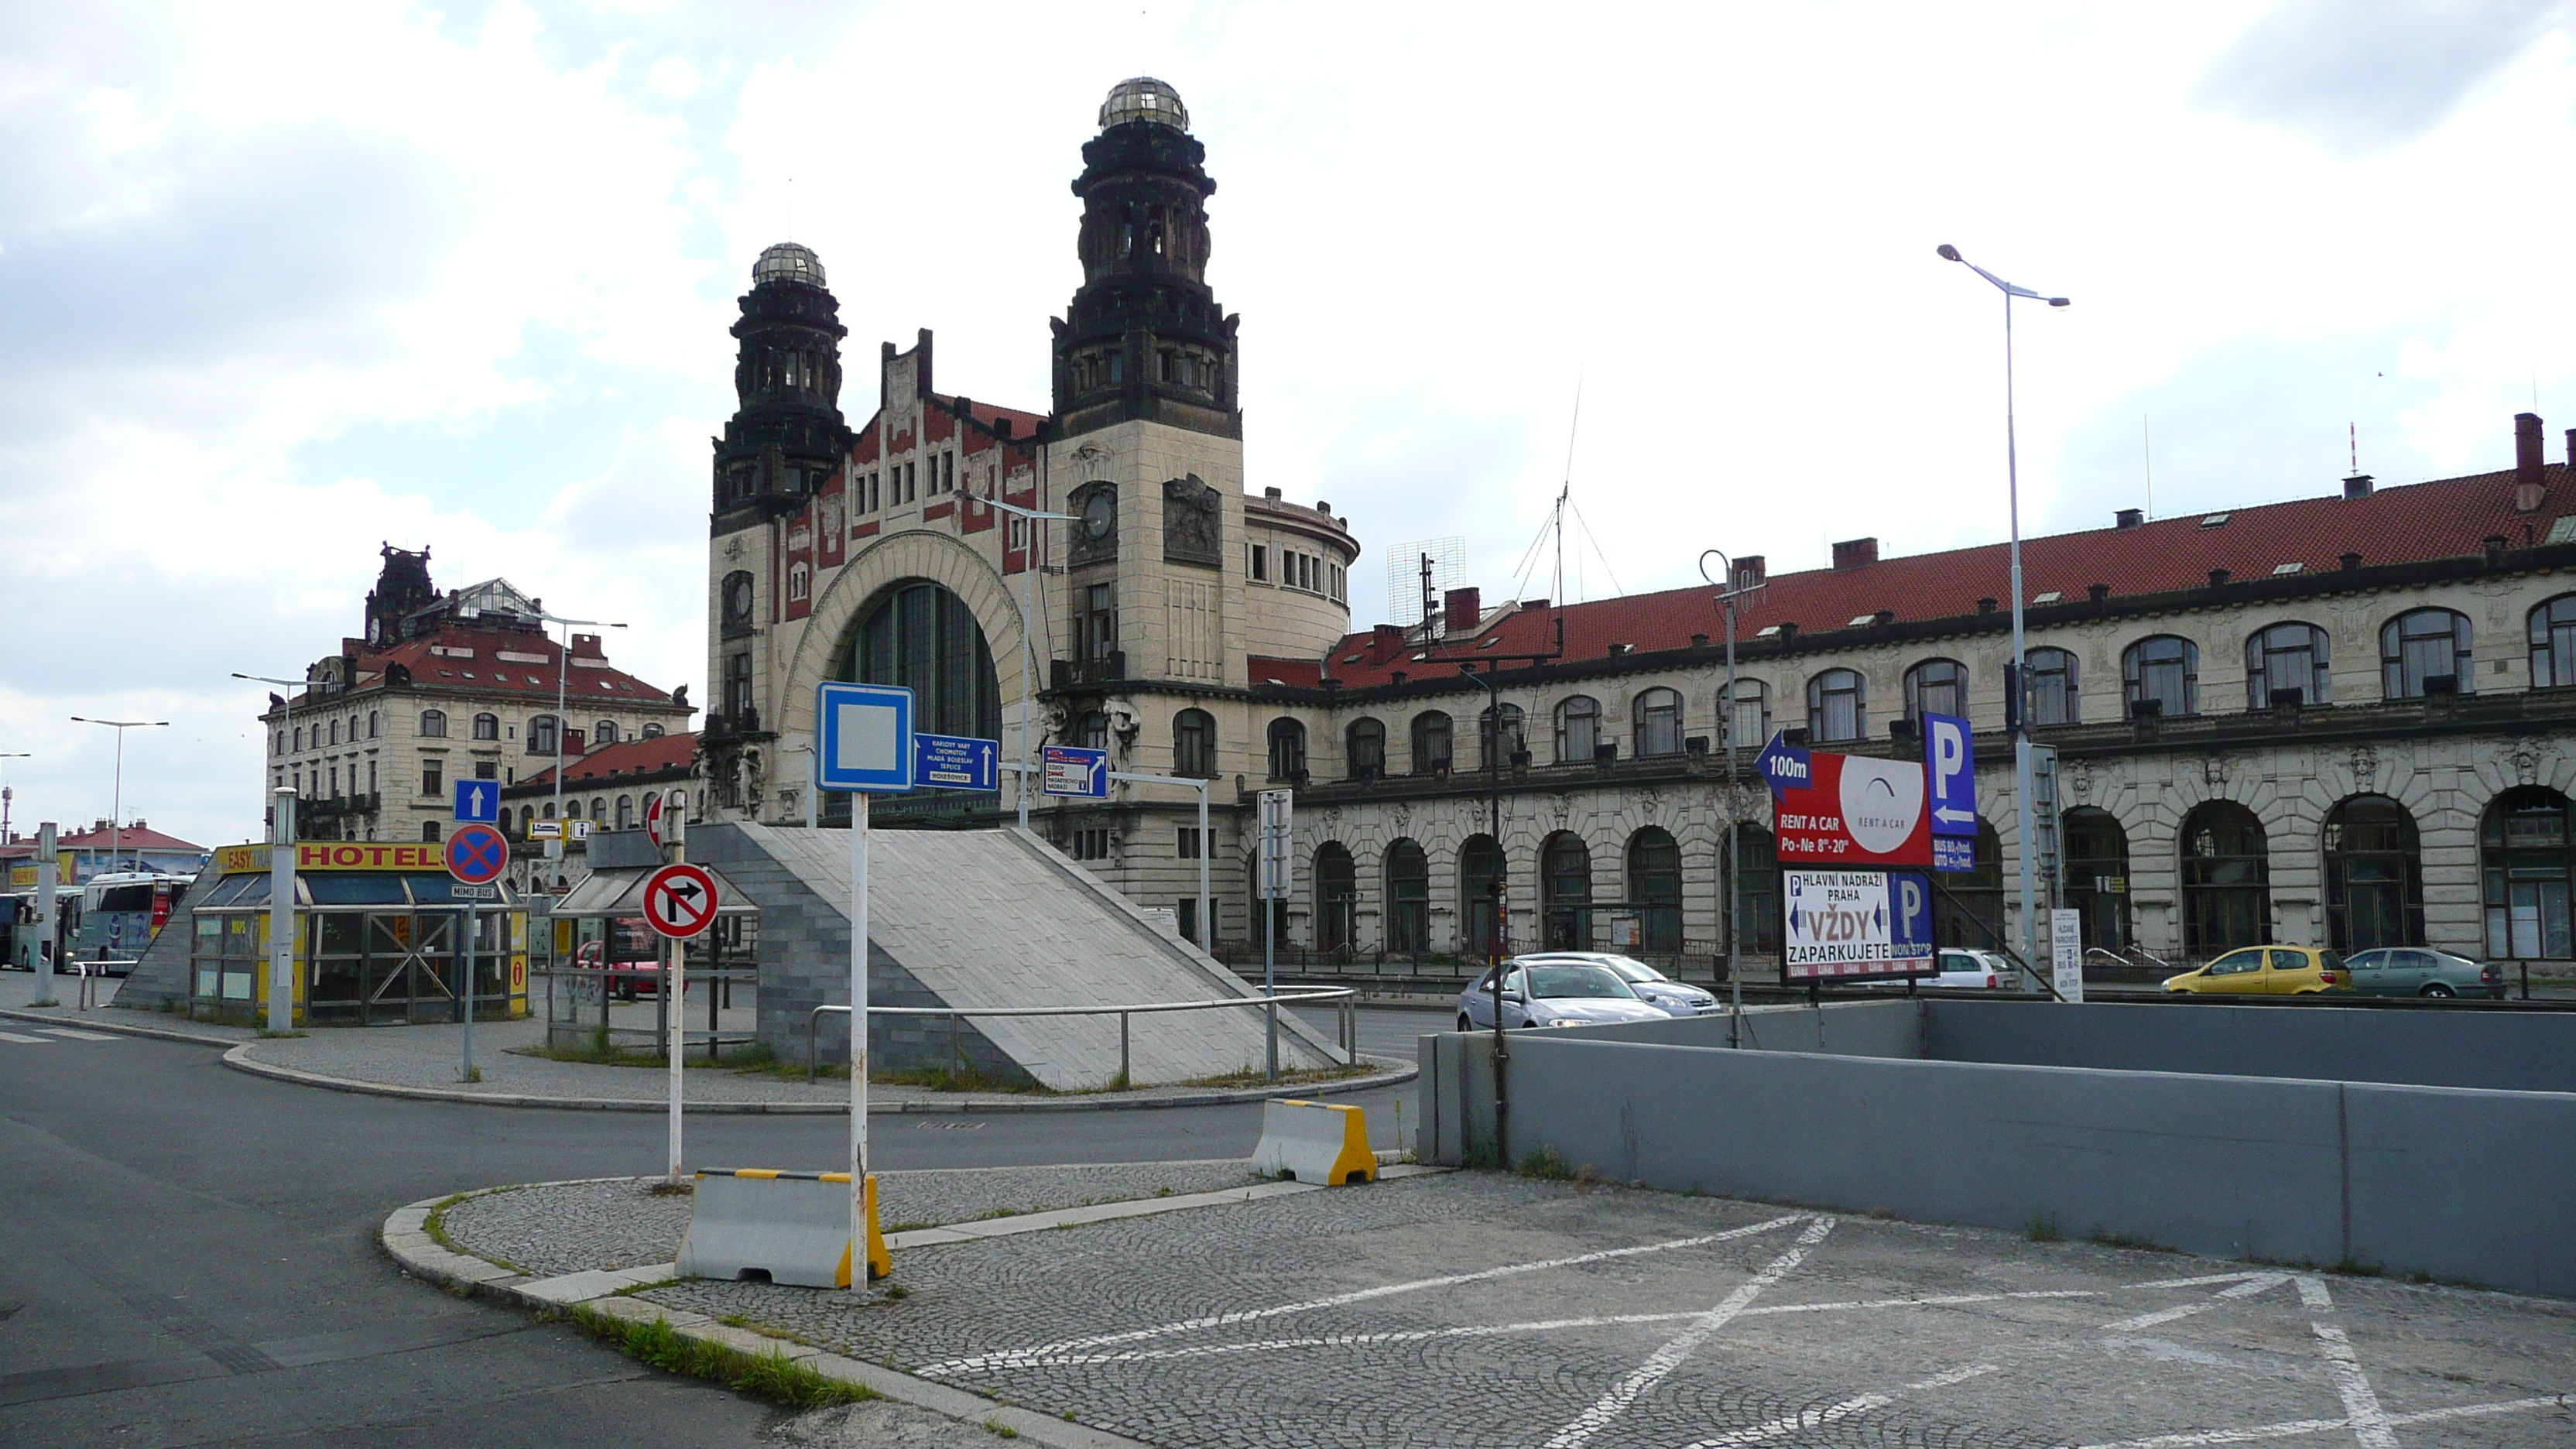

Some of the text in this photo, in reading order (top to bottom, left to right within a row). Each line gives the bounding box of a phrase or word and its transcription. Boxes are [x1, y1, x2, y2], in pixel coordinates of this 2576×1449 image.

[1769, 755, 1807, 779] 100m
[1934, 721, 1963, 799] P
[1781, 814, 1840, 831] RENT A CAR
[1858, 817, 1906, 830] RENT A CAR
[1934, 839, 1947, 852] BUS
[228, 850, 252, 869] EASY
[301, 846, 446, 866] HOTEL
[1803, 872, 1839, 886] HLAVNÍ
[1841, 873, 1883, 887] NÁDRAŽÍ
[454, 887, 492, 897] MIMO BUS
[1828, 889, 1860, 902] PRAHA
[1901, 880, 1921, 939] P
[1807, 903, 1870, 942] VŽDY
[1788, 943, 1889, 963] ZAPARKUJETE
[1891, 944, 1910, 956] NON
